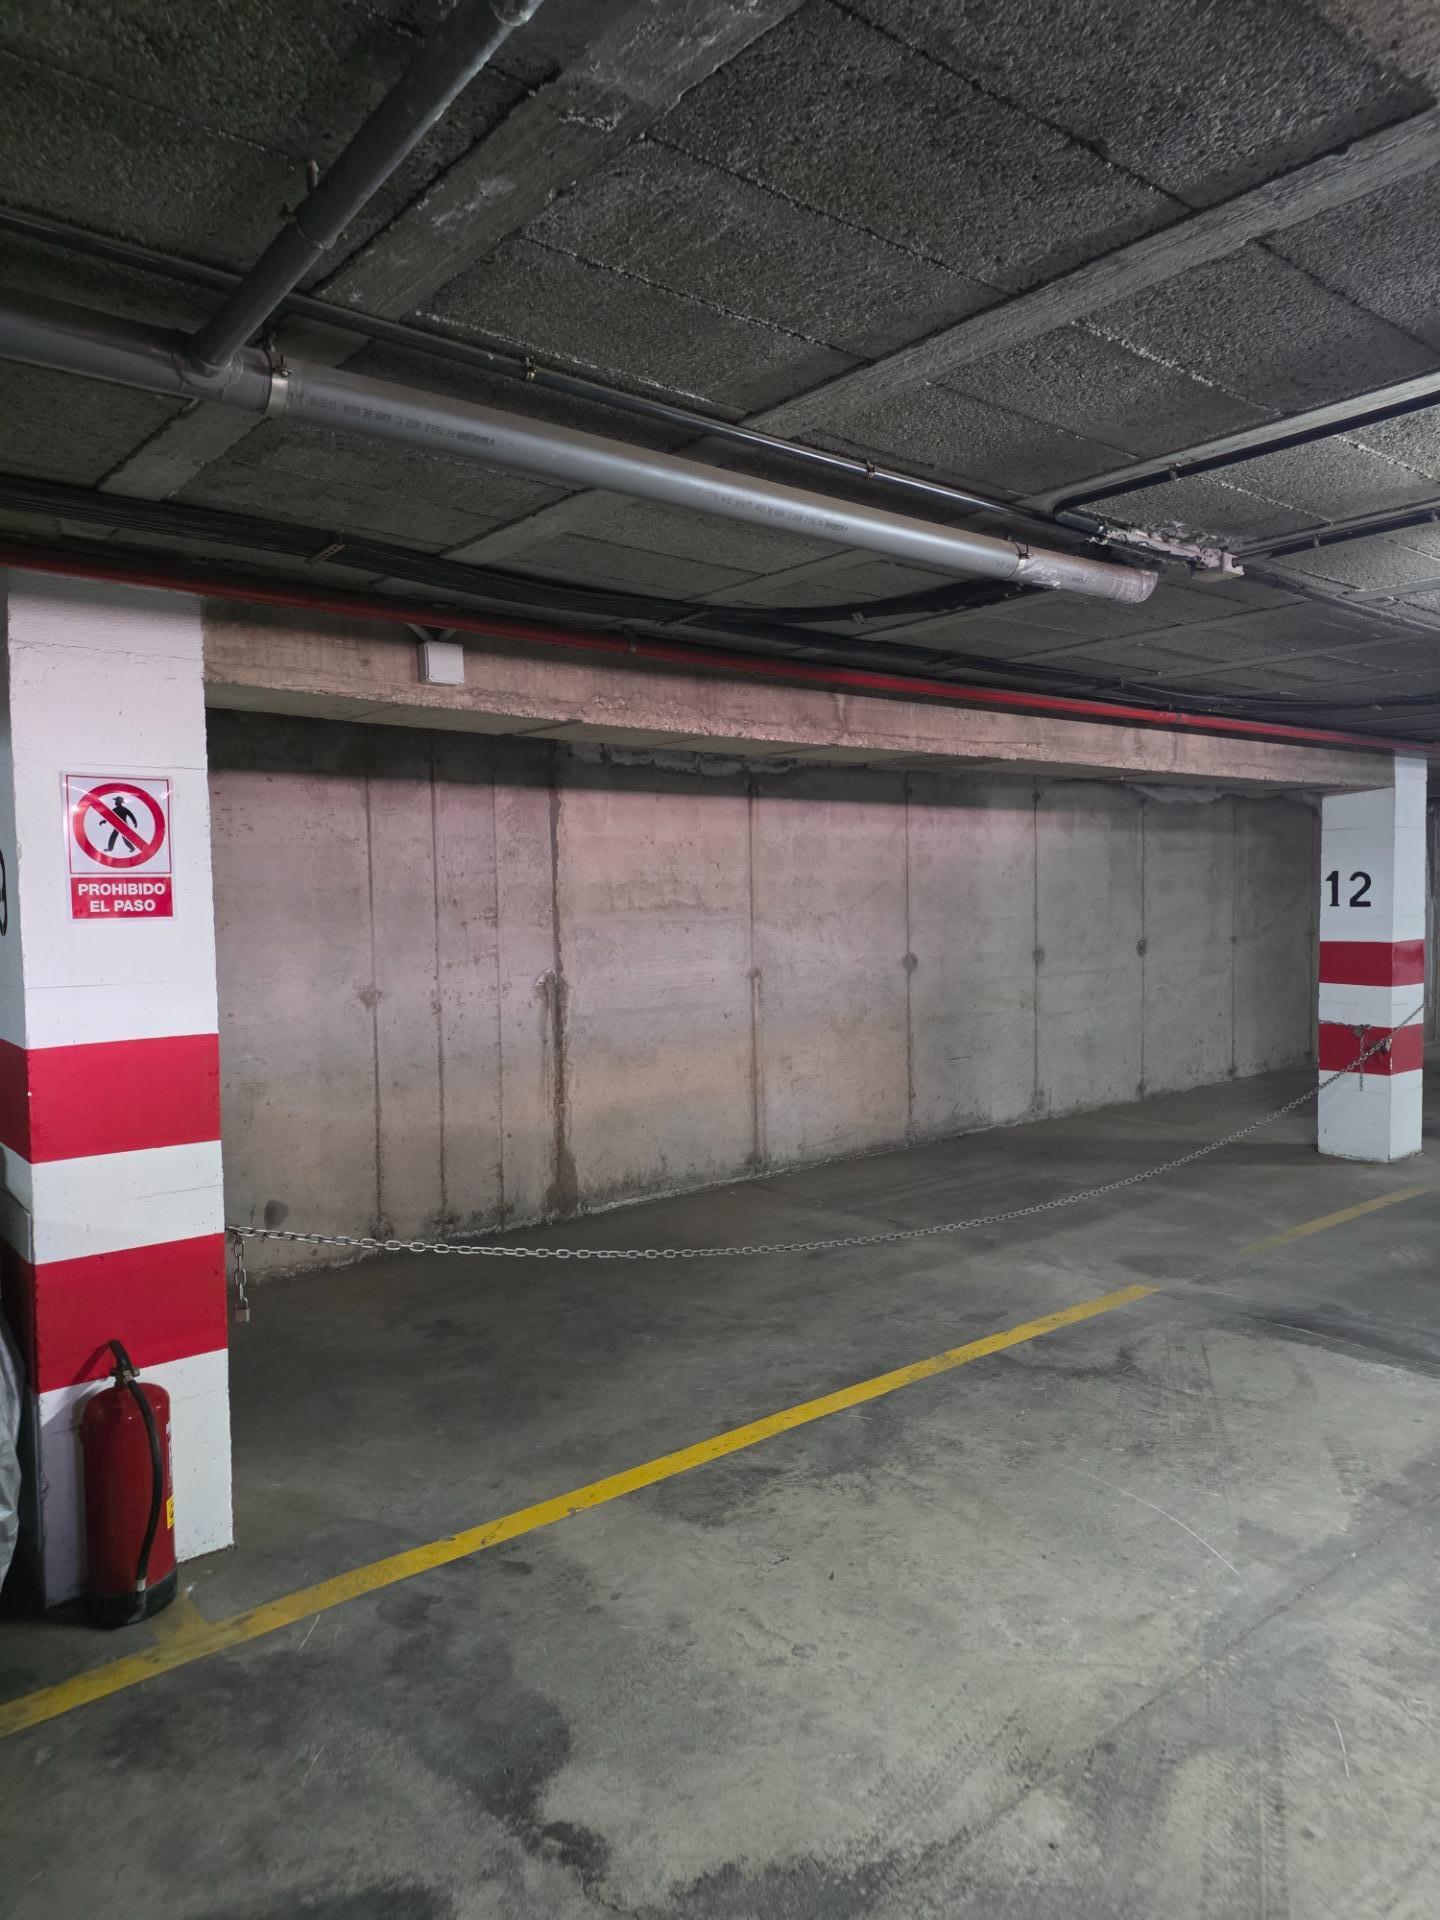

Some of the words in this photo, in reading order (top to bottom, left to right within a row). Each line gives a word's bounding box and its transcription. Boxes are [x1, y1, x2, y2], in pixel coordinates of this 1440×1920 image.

[77, 882, 166, 896] PROHIBIDO
[1325, 870, 1372, 907] 12
[89, 900, 110, 913] EL
[114, 899, 156, 912] PASO
